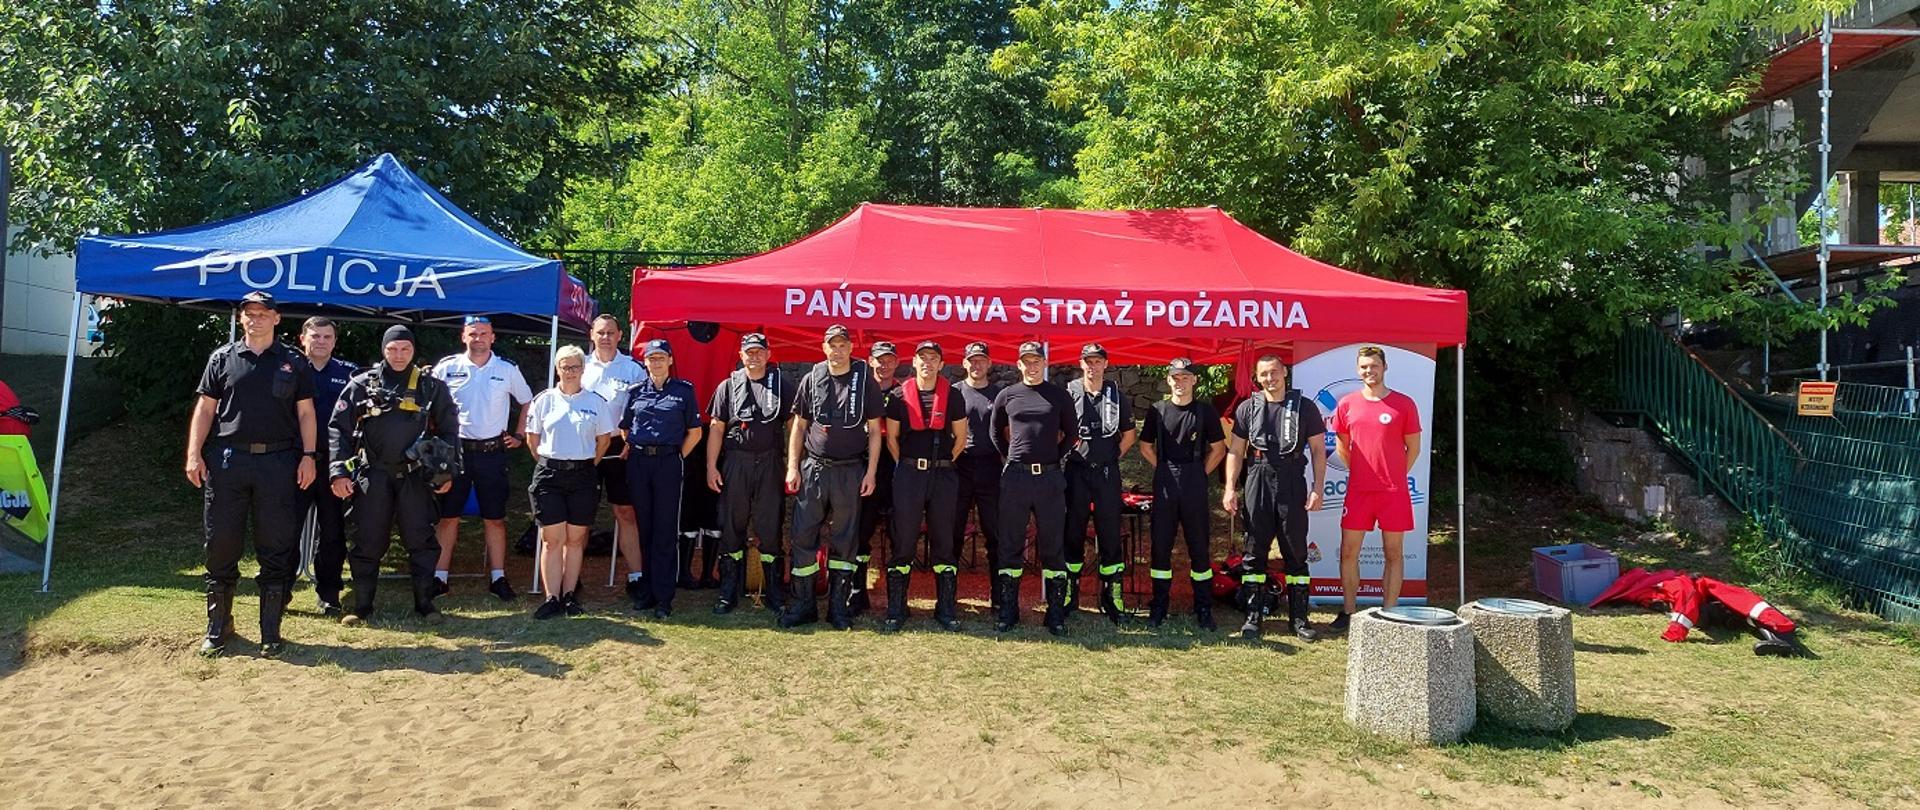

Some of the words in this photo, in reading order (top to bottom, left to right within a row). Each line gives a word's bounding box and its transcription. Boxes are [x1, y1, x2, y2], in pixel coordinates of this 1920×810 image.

[199, 254, 446, 300] POLICJA
[785, 283, 1008, 322] PAŃSTWOWA
[1020, 291, 1134, 325] STRAŻ
[1145, 291, 1310, 329] POŻARNA
